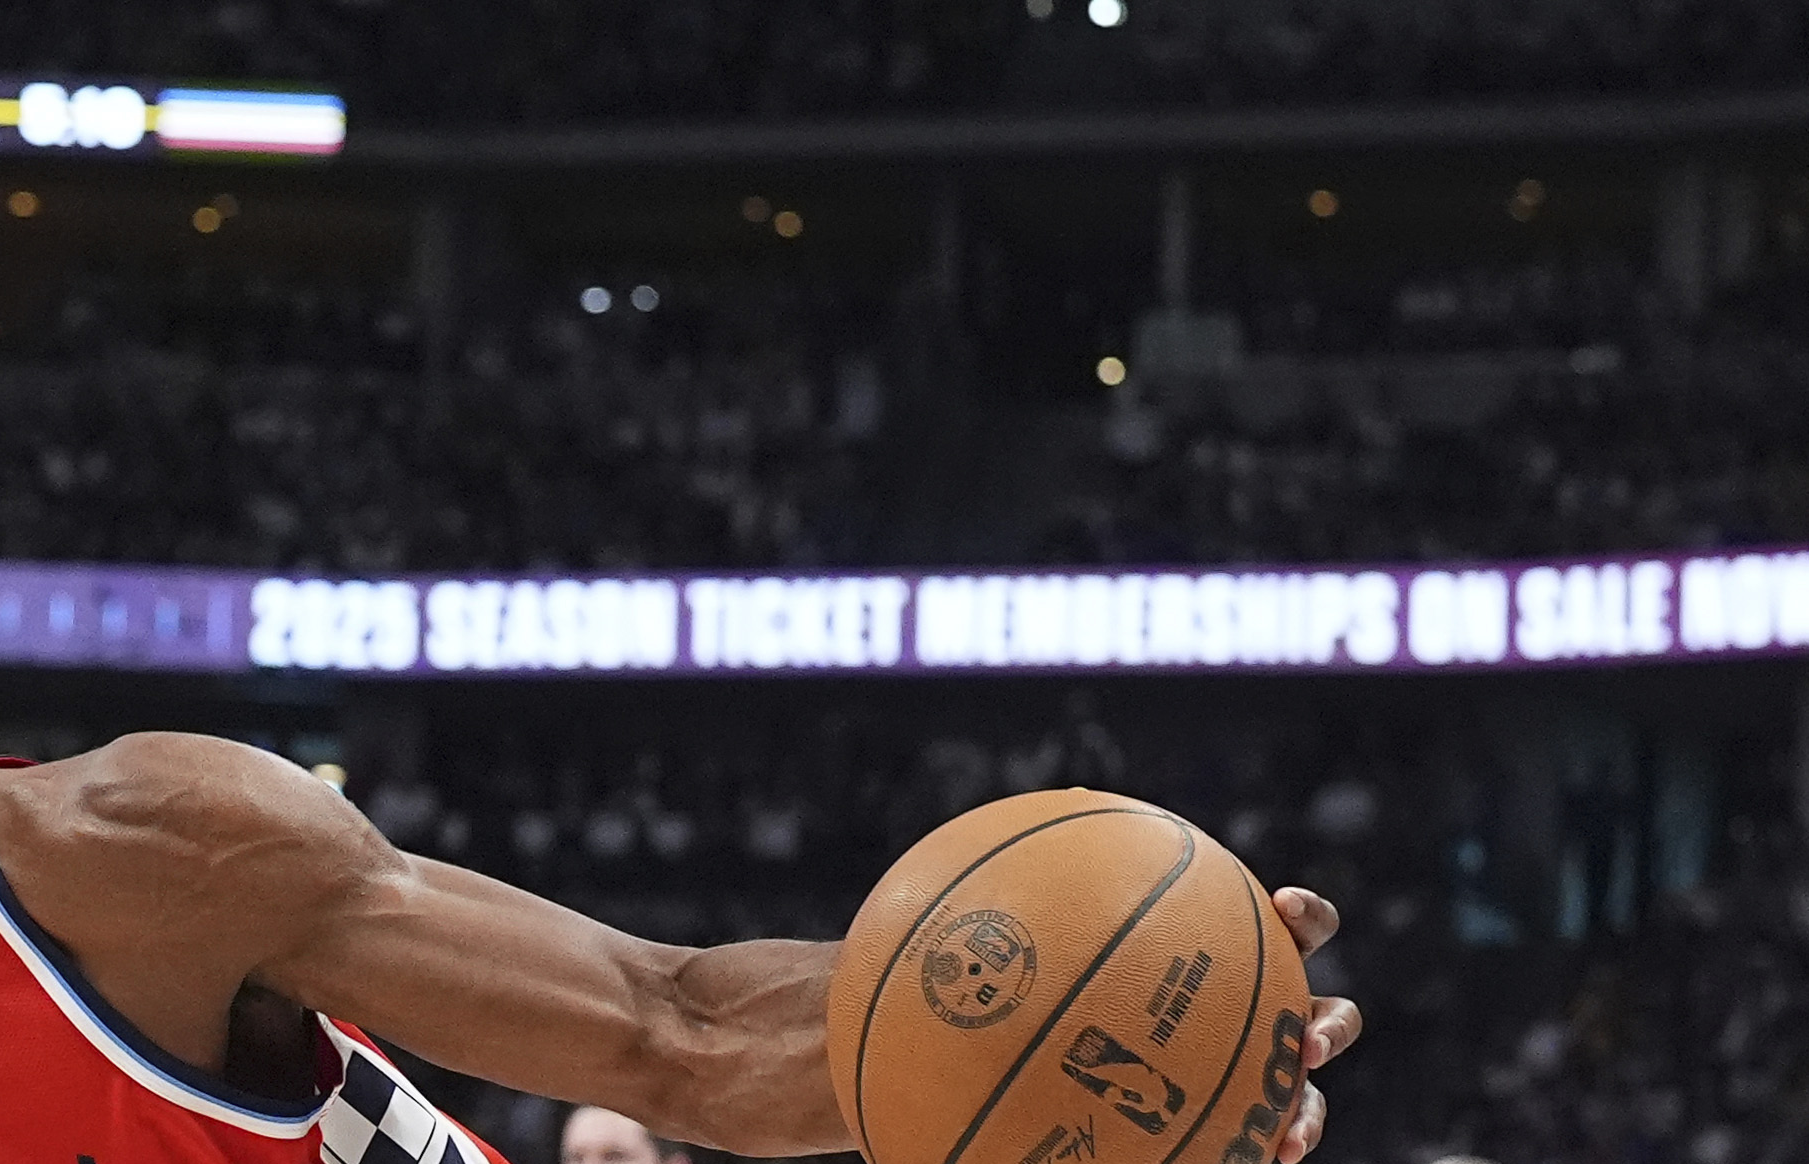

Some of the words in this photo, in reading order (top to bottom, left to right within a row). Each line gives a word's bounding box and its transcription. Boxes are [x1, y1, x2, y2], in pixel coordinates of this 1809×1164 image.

[249, 577, 419, 670] 2025
[426, 579, 678, 670] SEASON
[686, 576, 910, 667] TICKET
[916, 573, 1399, 666] MEMBERSHIPS
[1408, 571, 1508, 664] ON
[1516, 563, 1673, 660] SALE
